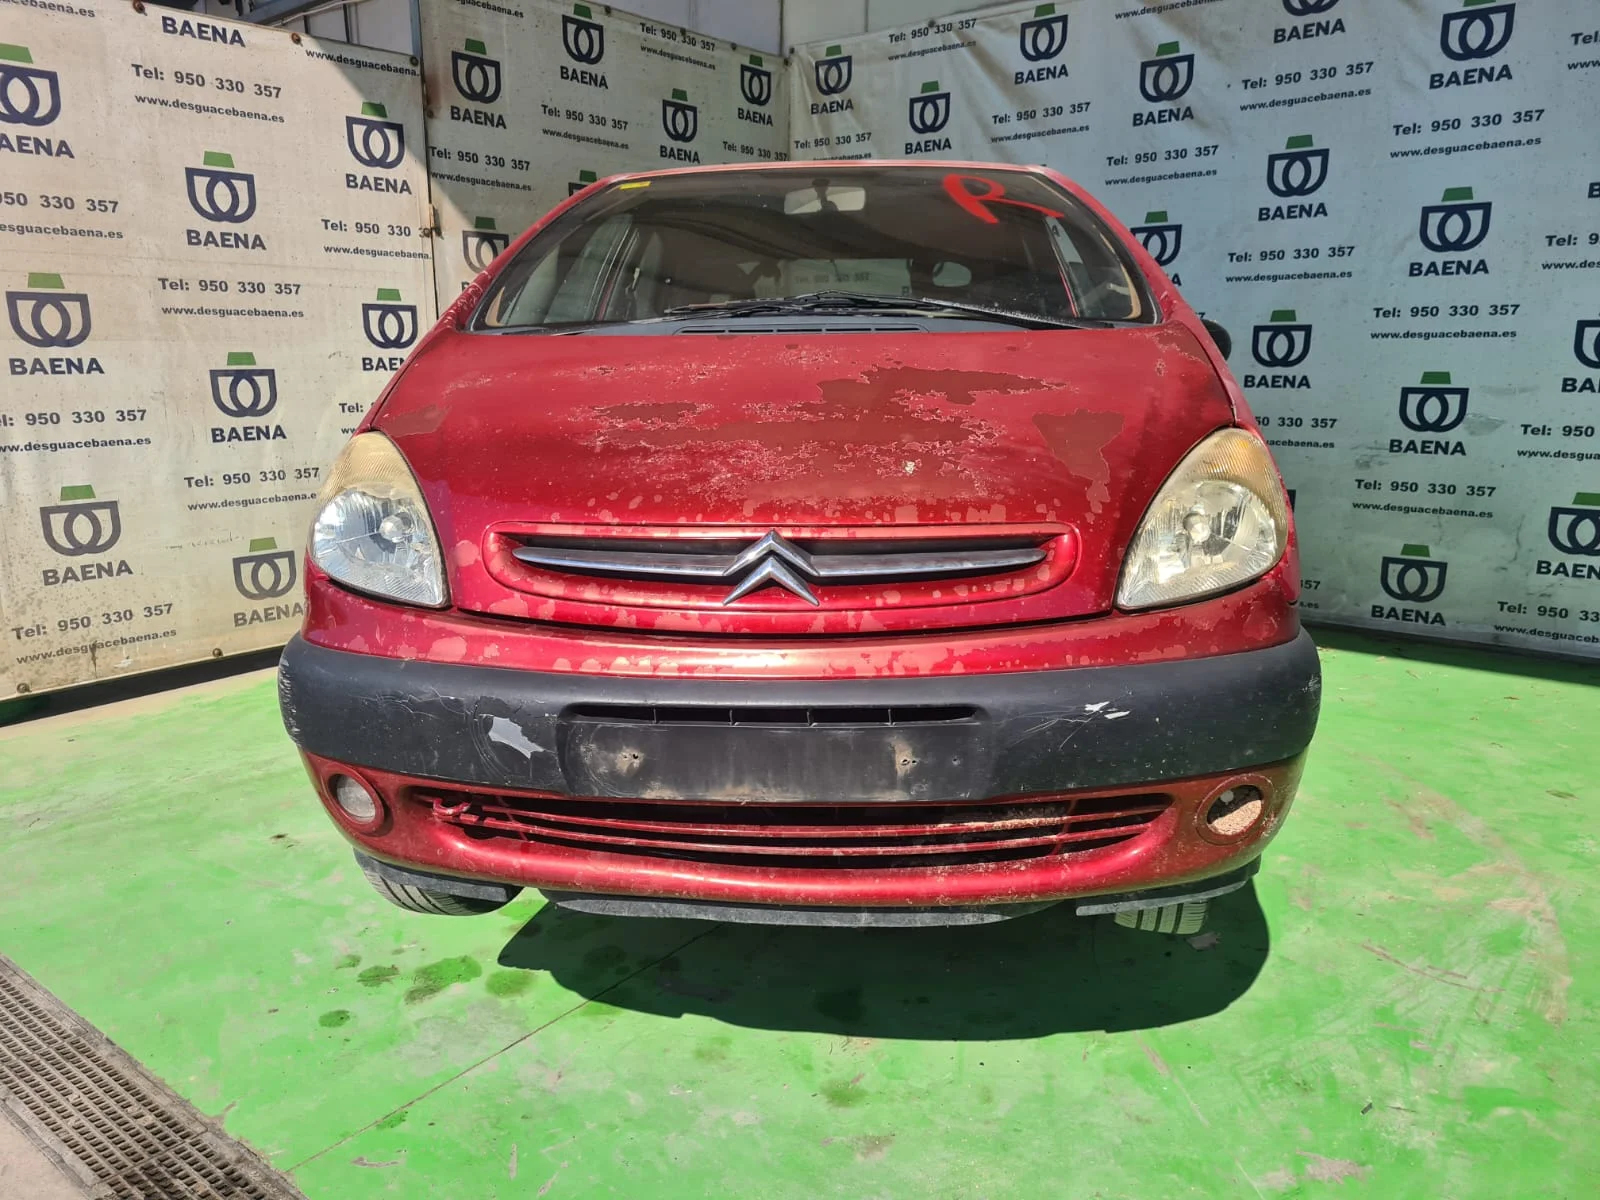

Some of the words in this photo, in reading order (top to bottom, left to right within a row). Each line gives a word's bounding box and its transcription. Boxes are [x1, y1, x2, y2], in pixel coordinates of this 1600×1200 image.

[161, 16, 246, 48] BAENA
[640, 22, 657, 36] Tel:
[660, 29, 677, 42] 950
[681, 35, 696, 47] 330
[700, 40, 715, 52] 357
[889, 33, 906, 44] Tel:
[911, 27, 930, 39] 950
[934, 22, 953, 34] 330
[958, 18, 977, 30] 357
[1274, 18, 1346, 44] BAENA
[1571, 30, 1600, 46] Tel
[640, 43, 716, 70] www.desguacebaena.es
[888, 39, 977, 61] www.desguacebaena.es
[305, 49, 420, 77] www.desguacebaena.
[131, 64, 164, 81] Tel:
[174, 71, 205, 87] 950
[215, 77, 245, 93] 330
[254, 84, 282, 99] 357
[560, 65, 608, 89] BAENA
[1014, 63, 1068, 85] BAENA
[1242, 77, 1267, 90] Tel:
[1275, 72, 1301, 86] 950
[1310, 66, 1337, 81] 330
[1345, 61, 1374, 76] 357
[1429, 63, 1513, 90] BAENA
[134, 94, 285, 123] www.desguacebaena.es
[810, 98, 854, 115] BAENA
[1239, 87, 1371, 111] www.desguacebaena.es
[450, 105, 507, 129] BAENA
[541, 104, 561, 118] Tel:
[565, 109, 584, 122] 950
[589, 114, 607, 127] 330
[611, 119, 629, 131] 357
[737, 107, 773, 127] BAENA
[992, 114, 1011, 125] Tel:
[1016, 109, 1036, 121] 950
[1043, 105, 1063, 118] 330
[1070, 102, 1090, 115] 357
[1132, 106, 1194, 127] BAENA
[1393, 123, 1422, 136] Tel:
[1431, 118, 1461, 132] 950
[1471, 114, 1502, 128] 330
[1512, 109, 1545, 123] 357
[542, 127, 629, 150] www.desguacebaena.es
[794, 139, 810, 149] Tel:
[814, 138, 830, 147] 950
[835, 135, 851, 145] 330
[856, 132, 872, 142] 357
[991, 124, 1090, 144] www.desguacebaena.es
[0, 133, 75, 159] AENA
[659, 145, 701, 164] BAENA
[722, 141, 737, 152] Tel:
[740, 144, 754, 155] 950
[757, 148, 771, 159] 330
[774, 151, 787, 161] 357
[904, 138, 952, 155] BAENA
[1106, 156, 1128, 167] Tel:
[1135, 152, 1157, 164] 950
[1164, 149, 1188, 160] 330
[1195, 145, 1219, 157] 357
[1390, 136, 1542, 158] www.desguacebaena.es
[430, 146, 451, 159] Tel:
[457, 151, 479, 164] 950
[485, 154, 505, 168] 330
[511, 159, 530, 171] 357
[345, 174, 413, 195] BAENA
[431, 171, 532, 191] www.desguacebaena.es
[1105, 168, 1217, 186] www.desguacebaena.es
[0, 191, 28, 206] 50
[40, 194, 75, 210] 330
[86, 198, 119, 213] 357
[1258, 202, 1328, 222] BAENA
[0, 223, 124, 239] esguacebaena.es
[321, 219, 347, 232] Tel:
[355, 222, 380, 235] 950
[387, 225, 411, 237] 330
[186, 229, 267, 250] BAENA
[1545, 234, 1577, 247] Tel:
[323, 245, 432, 260] www.desguacebaena.
[1228, 252, 1252, 263] Tel:
[1259, 249, 1285, 261] 950
[1293, 247, 1319, 259] 330
[1328, 246, 1355, 258] 357
[1225, 270, 1352, 283] www.desguacebaena.es
[1408, 259, 1489, 277] BAENA
[158, 277, 190, 291] Tel:
[199, 279, 229, 293] 950
[238, 281, 266, 294] 330
[274, 283, 301, 295] 357
[161, 305, 304, 318] www.desguacebaena.es
[1373, 307, 1401, 318] Tel:
[1410, 306, 1439, 317] 950
[1448, 305, 1479, 316] 330
[1488, 304, 1520, 316] 357
[1370, 330, 1517, 341] www.desguacebaena.es
[9, 357, 105, 376] BAENA
[362, 357, 405, 371] BAE
[1244, 374, 1311, 389] BAENA
[25, 412, 61, 426] 950
[72, 410, 105, 424] 330
[115, 409, 147, 422] 357
[338, 402, 364, 413] Tel:
[1255, 416, 1270, 426] 50
[1277, 416, 1303, 428] 330
[1311, 418, 1338, 429] 357
[1520, 424, 1552, 436] Tel:
[1562, 425, 1595, 437] 950
[211, 425, 287, 443] BAENA
[0, 438, 151, 452] ww.desguacebaena.es
[1388, 439, 1467, 456] BAENA
[184, 476, 214, 488] Tel:
[222, 472, 251, 485] 950
[259, 470, 286, 482] 330
[294, 467, 320, 480] 357
[1355, 479, 1382, 491] Tel:
[1390, 481, 1419, 493] 950
[1428, 483, 1457, 495] 330
[1466, 485, 1497, 498] 357
[187, 493, 317, 511] www.desguacebaena.e
[1352, 502, 1494, 519] www.desguacebaena.es
[42, 559, 134, 586] BAENA
[1536, 560, 1600, 580] BAEN
[12, 624, 48, 640] Tel:
[57, 616, 91, 632] 950
[101, 609, 134, 625] 330
[143, 603, 174, 618] 357
[233, 602, 304, 627] BAENA
[1371, 605, 1447, 627] BAENA
[1497, 601, 1527, 614] Tel:
[1537, 606, 1569, 619] 950
[1579, 610, 1600, 622] 33
[1494, 624, 1600, 644] www.desguaceb
[16, 628, 177, 665] www.desguacebaena.es
